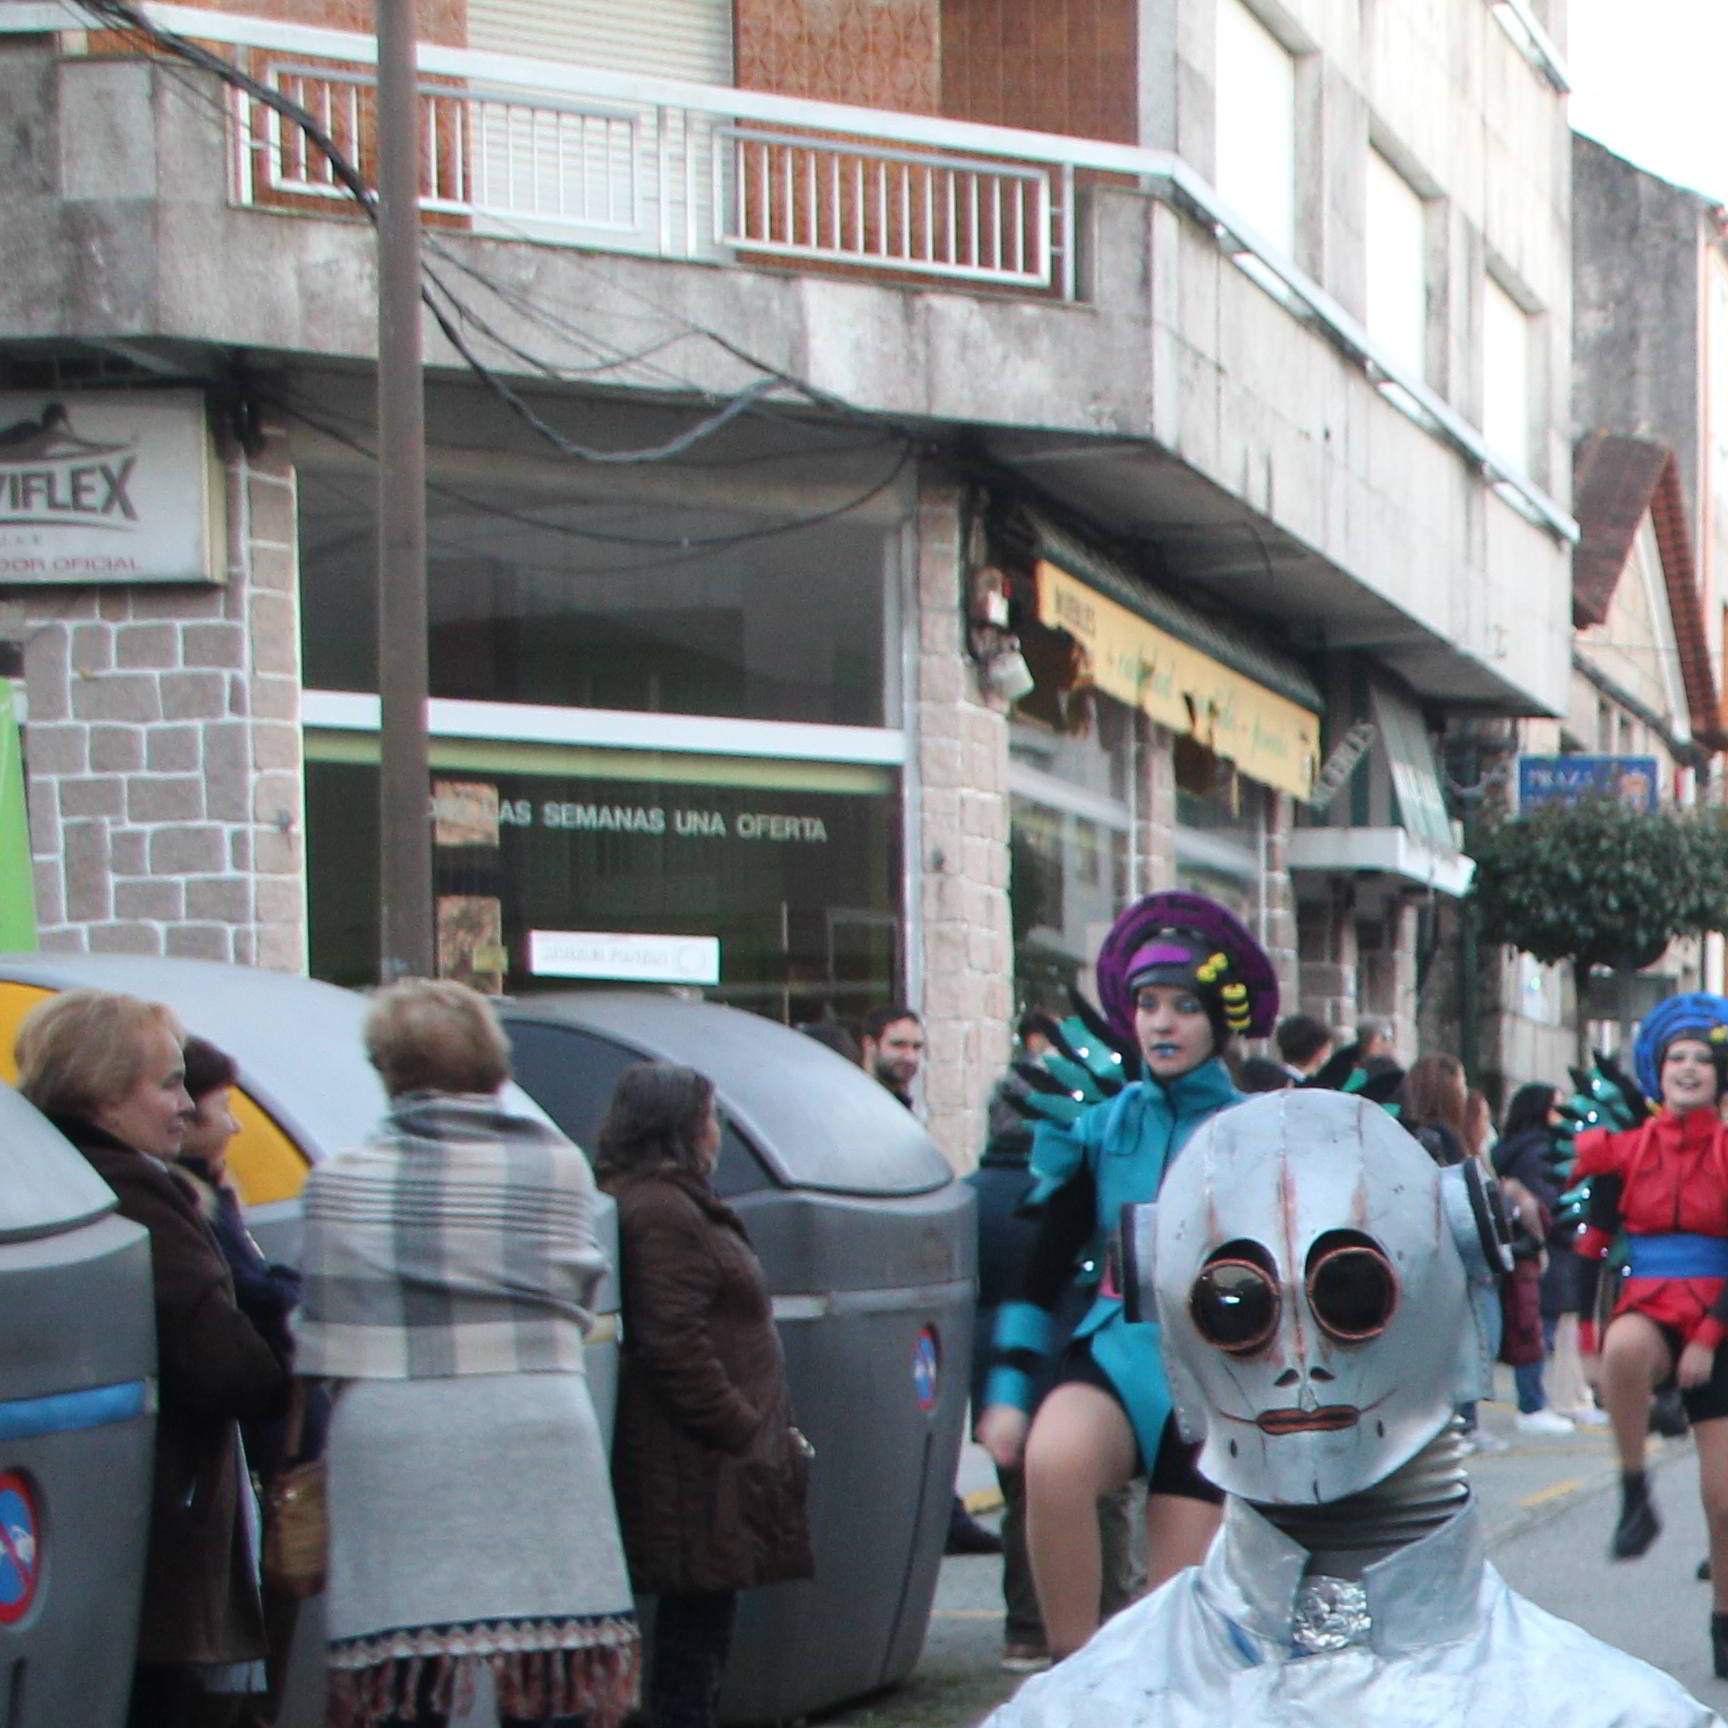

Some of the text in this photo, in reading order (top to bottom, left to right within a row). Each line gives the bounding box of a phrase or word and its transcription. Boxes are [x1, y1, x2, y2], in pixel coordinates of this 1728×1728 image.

[543, 801, 666, 836] SEMANAS
[676, 809, 727, 838] UNA
[736, 814, 828, 843] OFERTA
